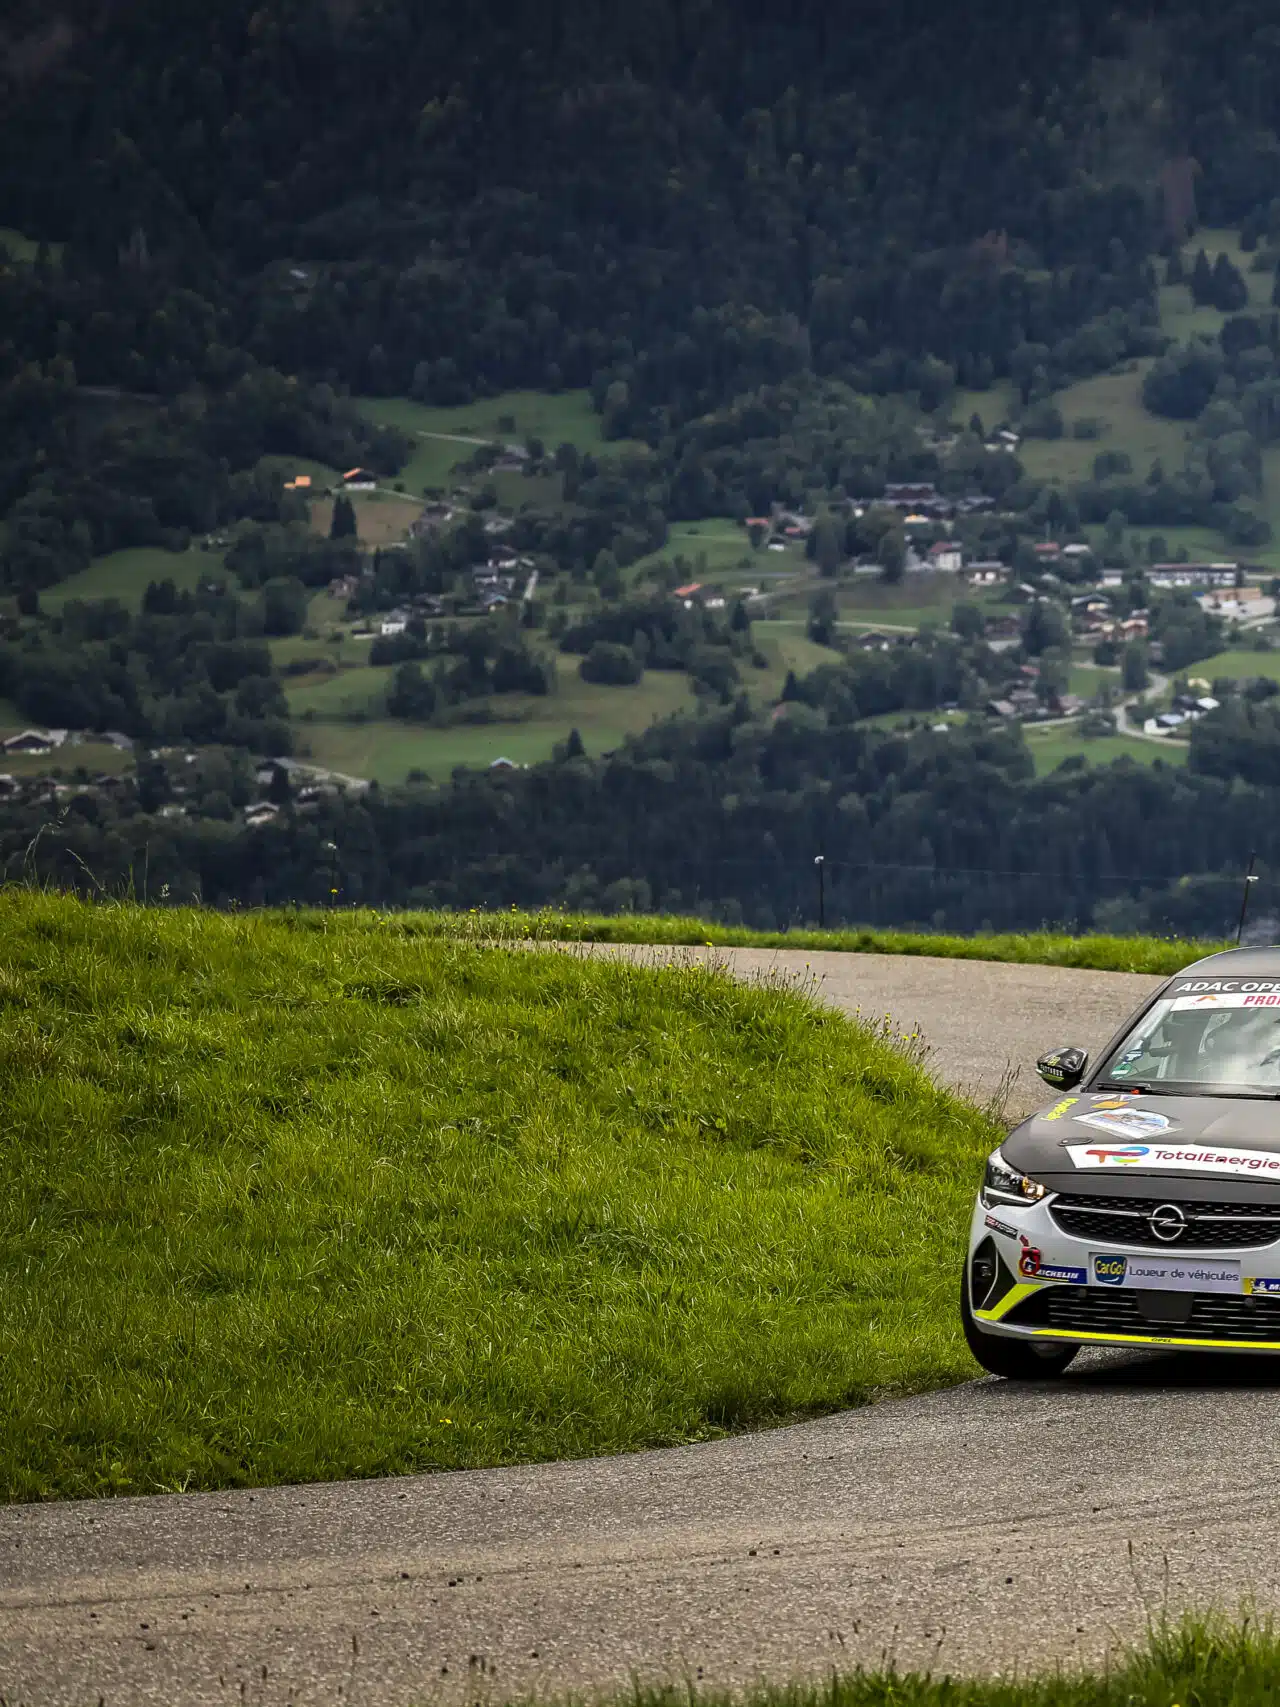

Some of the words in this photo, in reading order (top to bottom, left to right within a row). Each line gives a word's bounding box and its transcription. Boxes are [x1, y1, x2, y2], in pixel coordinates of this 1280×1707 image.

[1175, 982, 1239, 992] ADAC
[1095, 1260, 1126, 1275] CarGo!
[1129, 1266, 1169, 1277] Loueur
[1170, 1268, 1185, 1279] de
[1187, 1269, 1240, 1282] véhicules
